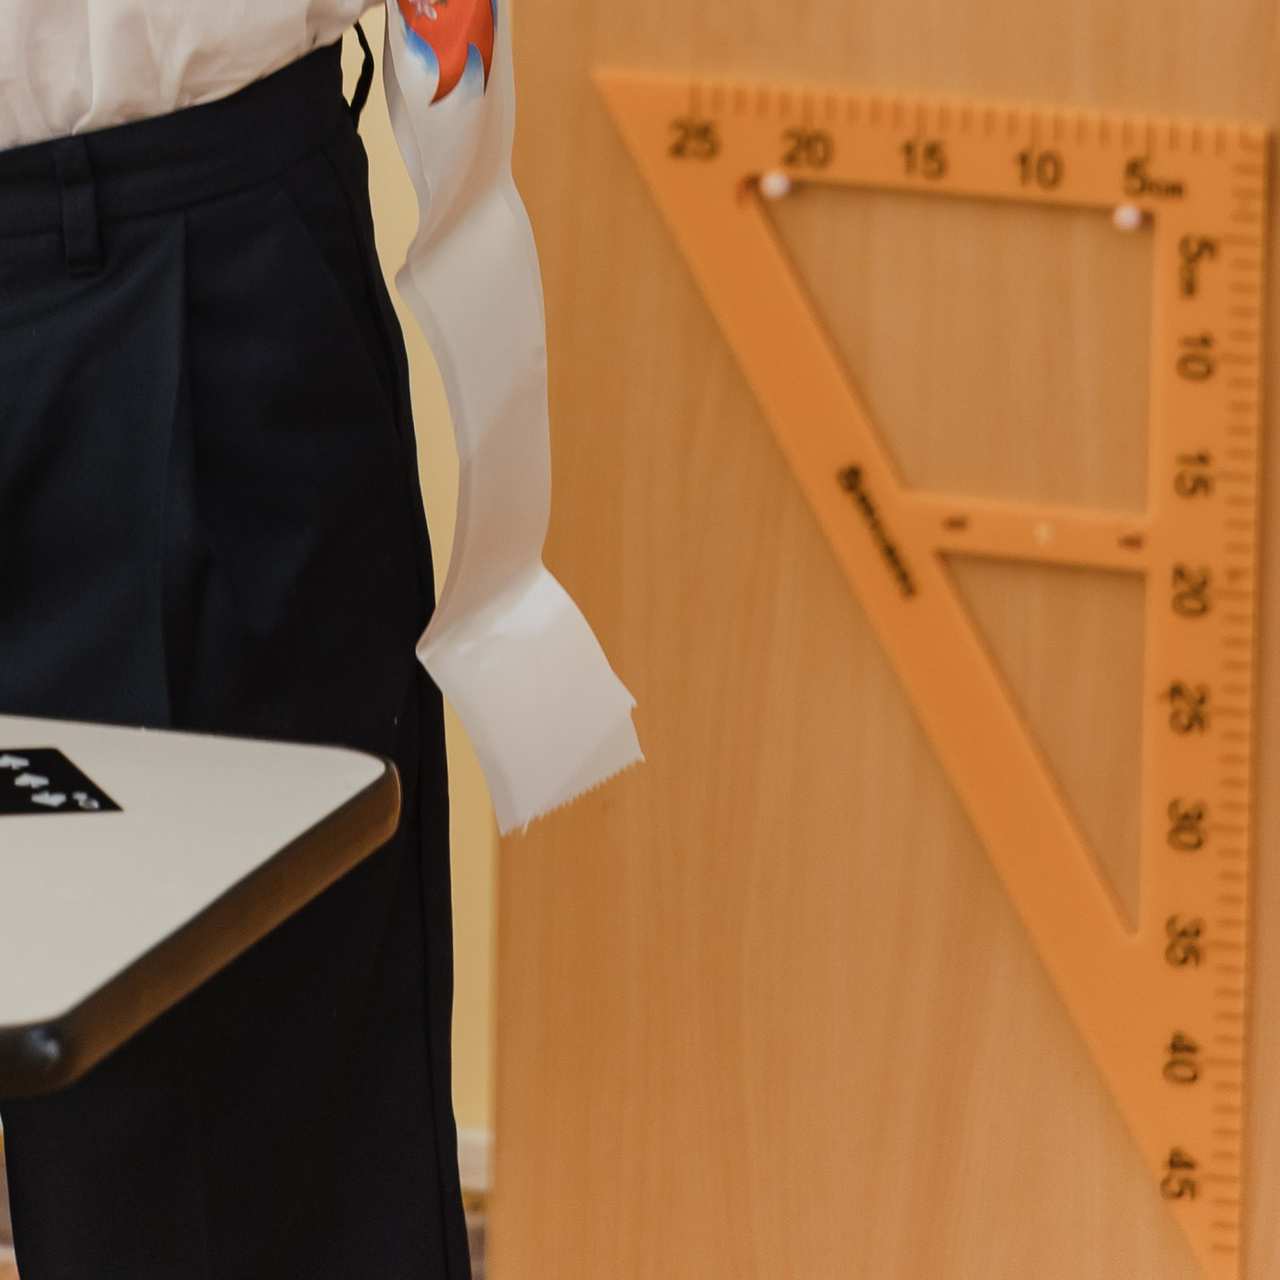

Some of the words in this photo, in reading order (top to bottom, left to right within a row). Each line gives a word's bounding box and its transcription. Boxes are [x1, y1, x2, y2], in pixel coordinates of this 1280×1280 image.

[669, 118, 718, 161] 25
[782, 125, 834, 169] 20
[901, 139, 948, 180] 15
[1016, 149, 1063, 191] 10
[1176, 334, 1213, 382] 10
[1174, 450, 1213, 500] 15
[1171, 562, 1210, 618] 20
[1166, 680, 1209, 736] 25
[1166, 797, 1207, 852] 30
[1164, 913, 1204, 968] 35
[1162, 1030, 1201, 1086] 40
[1159, 1146, 1198, 1202] 45
